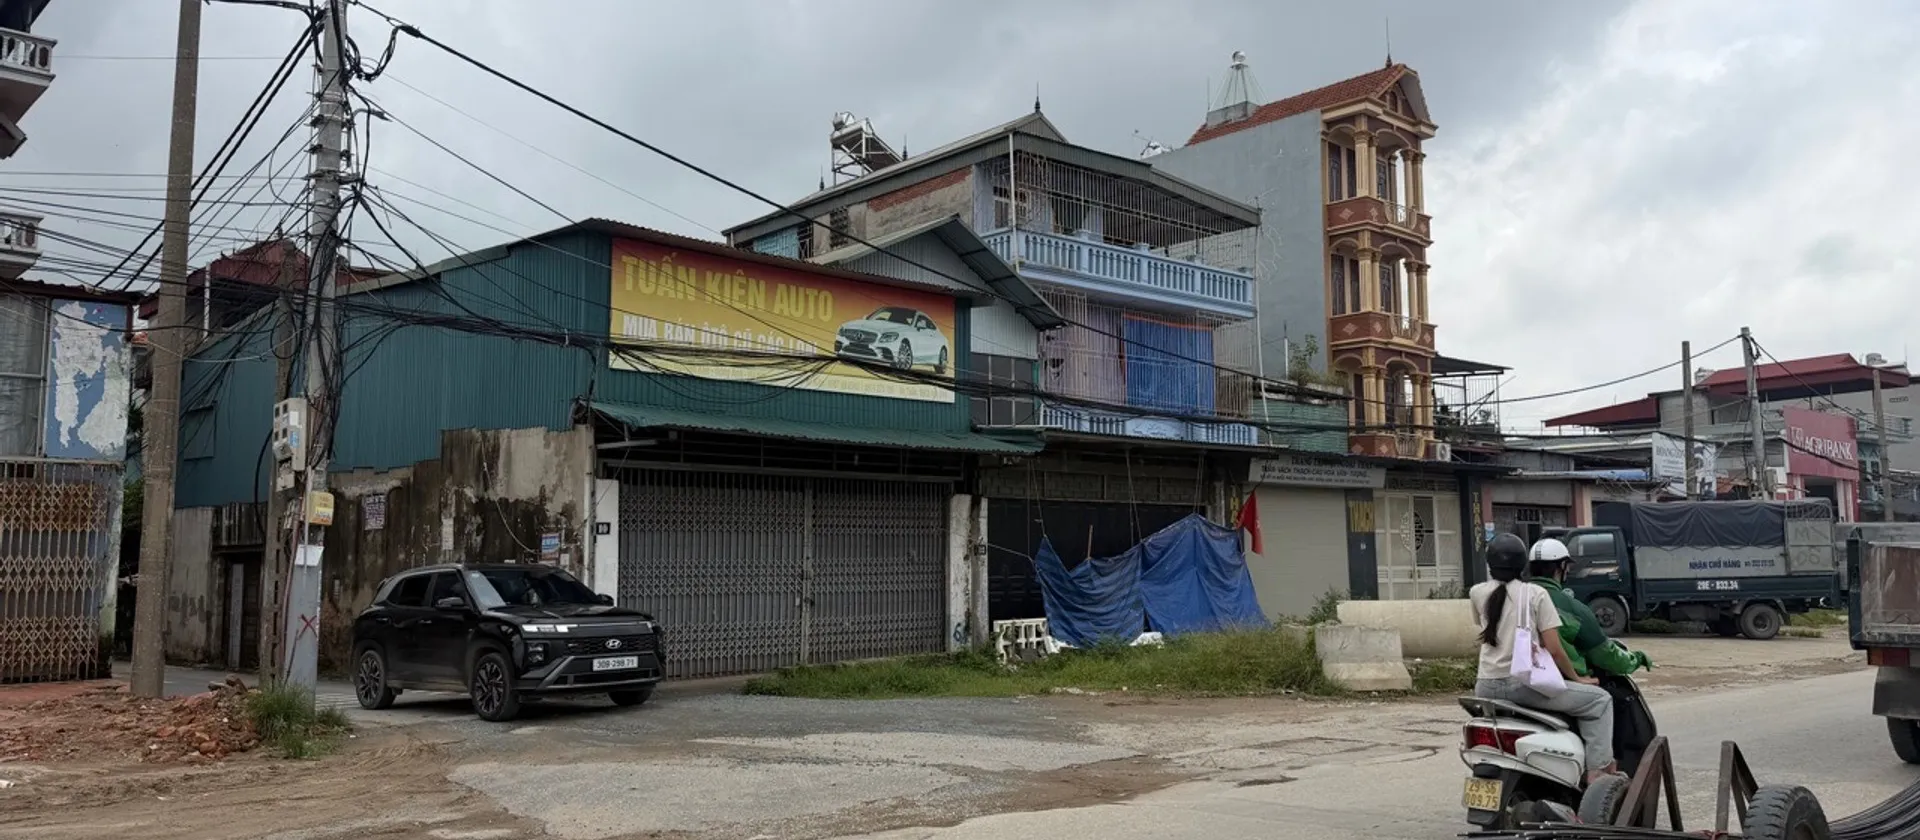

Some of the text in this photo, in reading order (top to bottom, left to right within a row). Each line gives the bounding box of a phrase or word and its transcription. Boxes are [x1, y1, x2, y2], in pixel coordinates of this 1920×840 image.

[620, 252, 834, 322] TUẤN KIÊN AUTO
[622, 313, 658, 341] MUA
[663, 317, 696, 345] BÁN
[1804, 435, 1854, 461] AGRIBANK
